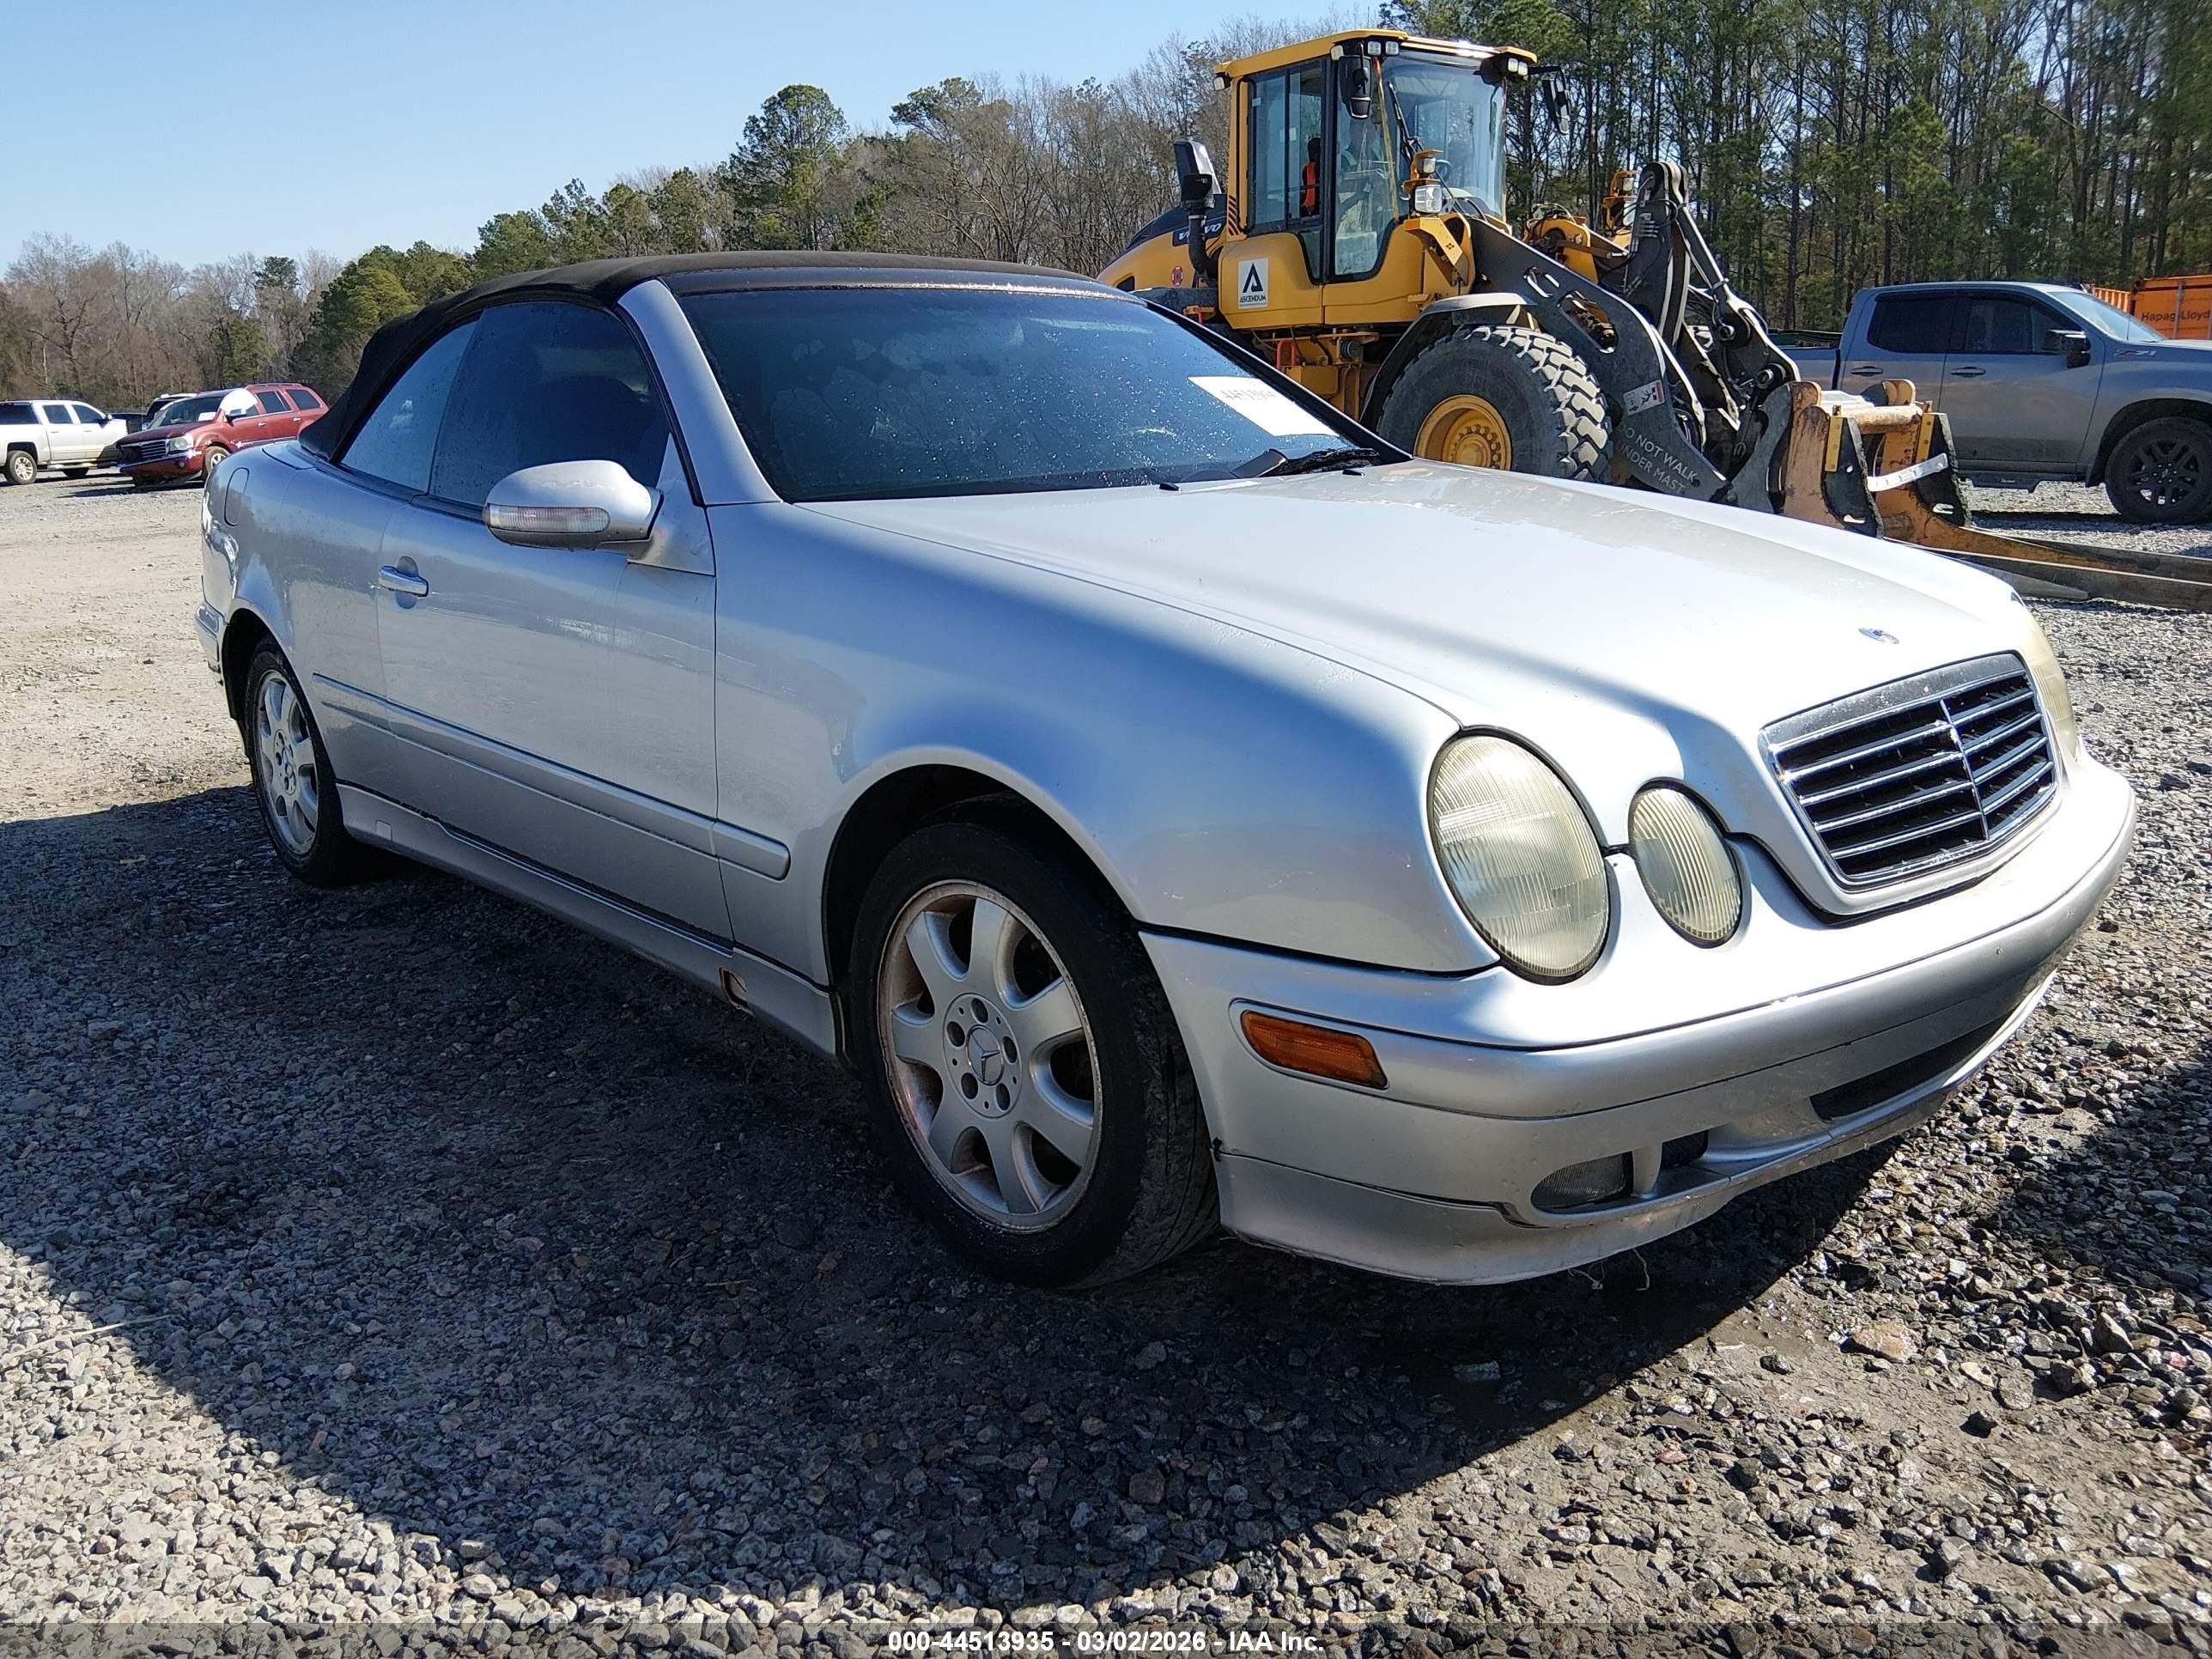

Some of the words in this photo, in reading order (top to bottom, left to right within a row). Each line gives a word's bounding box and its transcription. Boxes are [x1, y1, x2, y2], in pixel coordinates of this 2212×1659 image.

[1635, 434, 1662, 457] NOT
[1663, 453, 1698, 482] WALK
[1653, 468, 1686, 494] MAST
